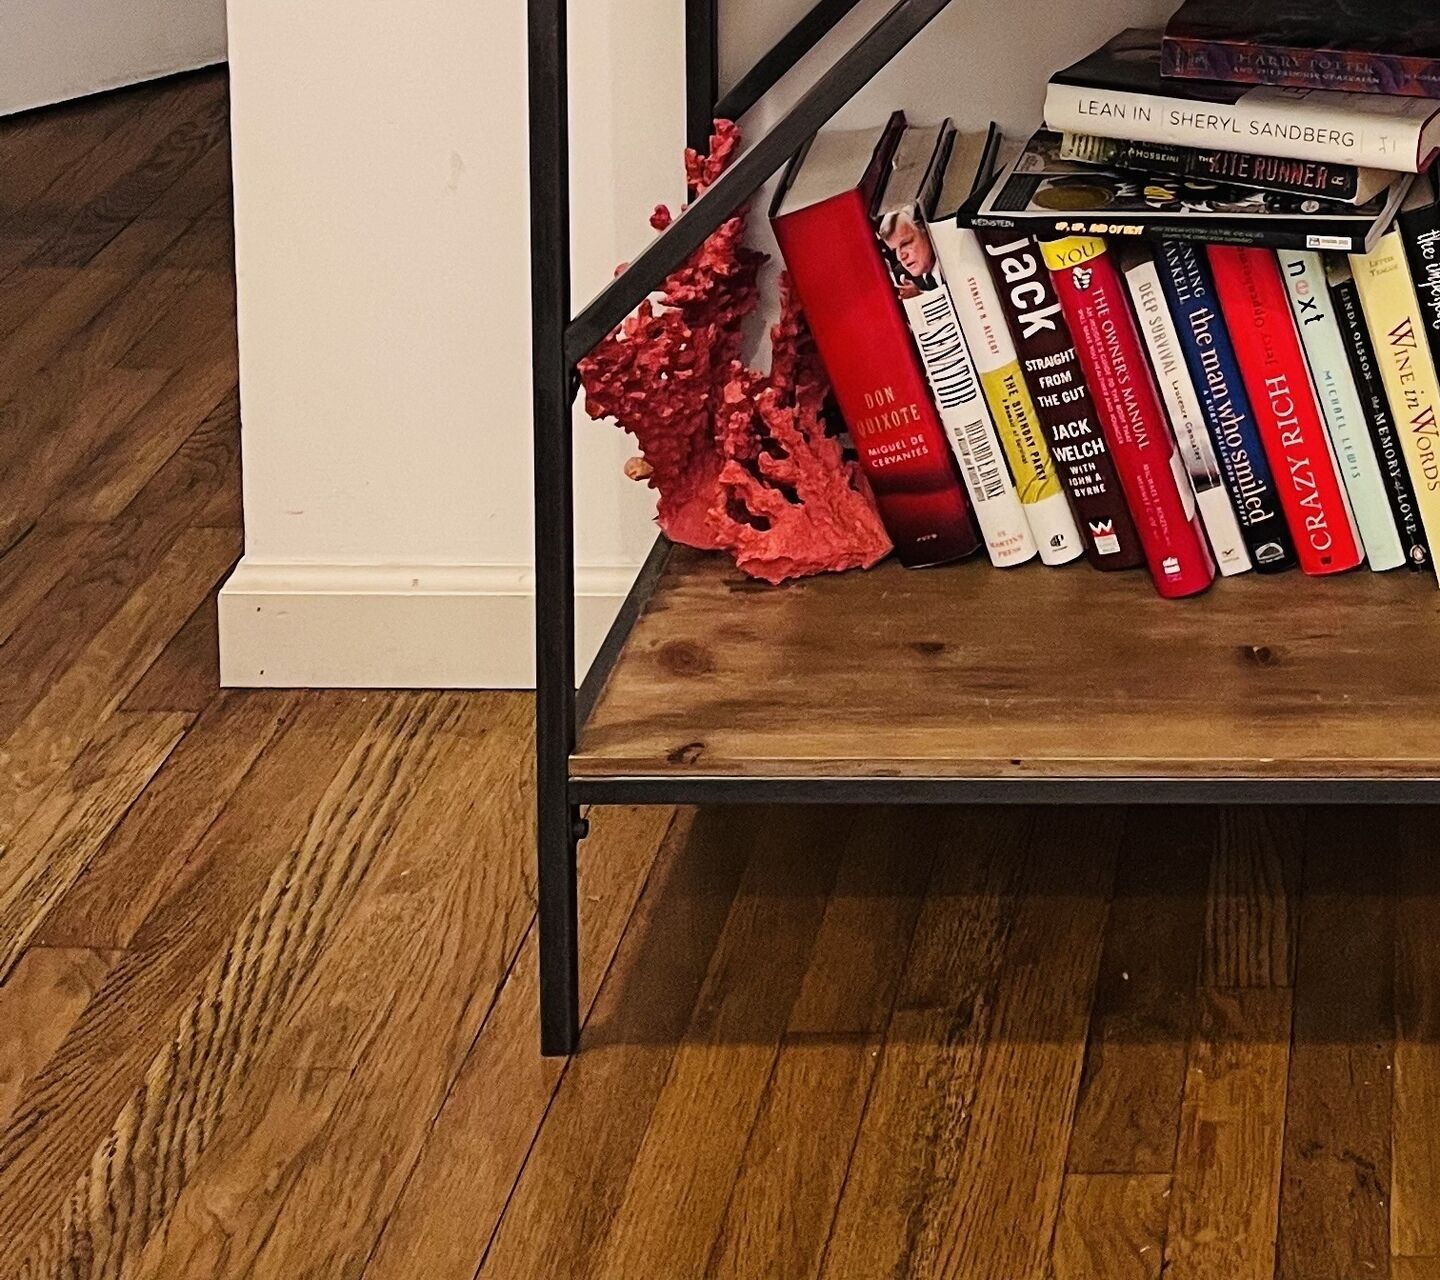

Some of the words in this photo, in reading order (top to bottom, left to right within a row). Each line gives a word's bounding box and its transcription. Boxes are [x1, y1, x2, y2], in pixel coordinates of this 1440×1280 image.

[1077, 98, 1126, 119] LEAN
[1131, 105, 1151, 122] IN
[1168, 108, 1243, 134] SHERYL
[1247, 118, 1356, 148] SANDBERG
[1207, 148, 1251, 178] KITE
[1251, 152, 1329, 192] RUNNER
[1056, 241, 1096, 265] YOU
[986, 234, 1062, 339] jack
[1090, 287, 1110, 317] THE
[1136, 281, 1159, 314] DEEP
[1286, 258, 1325, 326] next
[919, 293, 952, 326] THE
[1186, 305, 1222, 348] the
[1146, 314, 1179, 376] SURVIVAL
[1338, 287, 1358, 329] LINDA
[1350, 330, 1373, 381] OLSSON
[917, 321, 979, 411] SENATOR
[1025, 347, 1077, 371] STRAIGHT
[1099, 318, 1131, 385] OWNER'S
[1002, 374, 1019, 397] THE
[1038, 370, 1072, 389] FROM
[1198, 346, 1230, 400] man
[864, 387, 895, 409] DON
[1037, 393, 1060, 408] THE
[1061, 385, 1085, 402] GUT
[1263, 372, 1304, 448] RICH
[1402, 385, 1427, 410] in
[857, 403, 921, 438] QUIXOTE
[1010, 400, 1036, 449] BIRTHDAY
[1052, 418, 1092, 441] JACK
[1120, 386, 1151, 451] MANUAL
[1215, 398, 1252, 449] who
[1321, 369, 1346, 429] MICHAEL
[1341, 437, 1361, 479] LEWIS
[868, 439, 907, 457] MIGUEL
[911, 434, 925, 446] DE
[871, 446, 929, 468] CERVANTES
[1052, 438, 1106, 462] WELCH
[1028, 450, 1047, 482] PARTY
[1068, 474, 1093, 487] JOHN
[1069, 462, 1096, 475] WITH
[1372, 410, 1402, 480] MEMORY
[1395, 492, 1417, 535] LOVE
[1074, 483, 1107, 498] BYRNE
[1229, 445, 1275, 524] smiled
[1286, 450, 1334, 553] CRAZY
